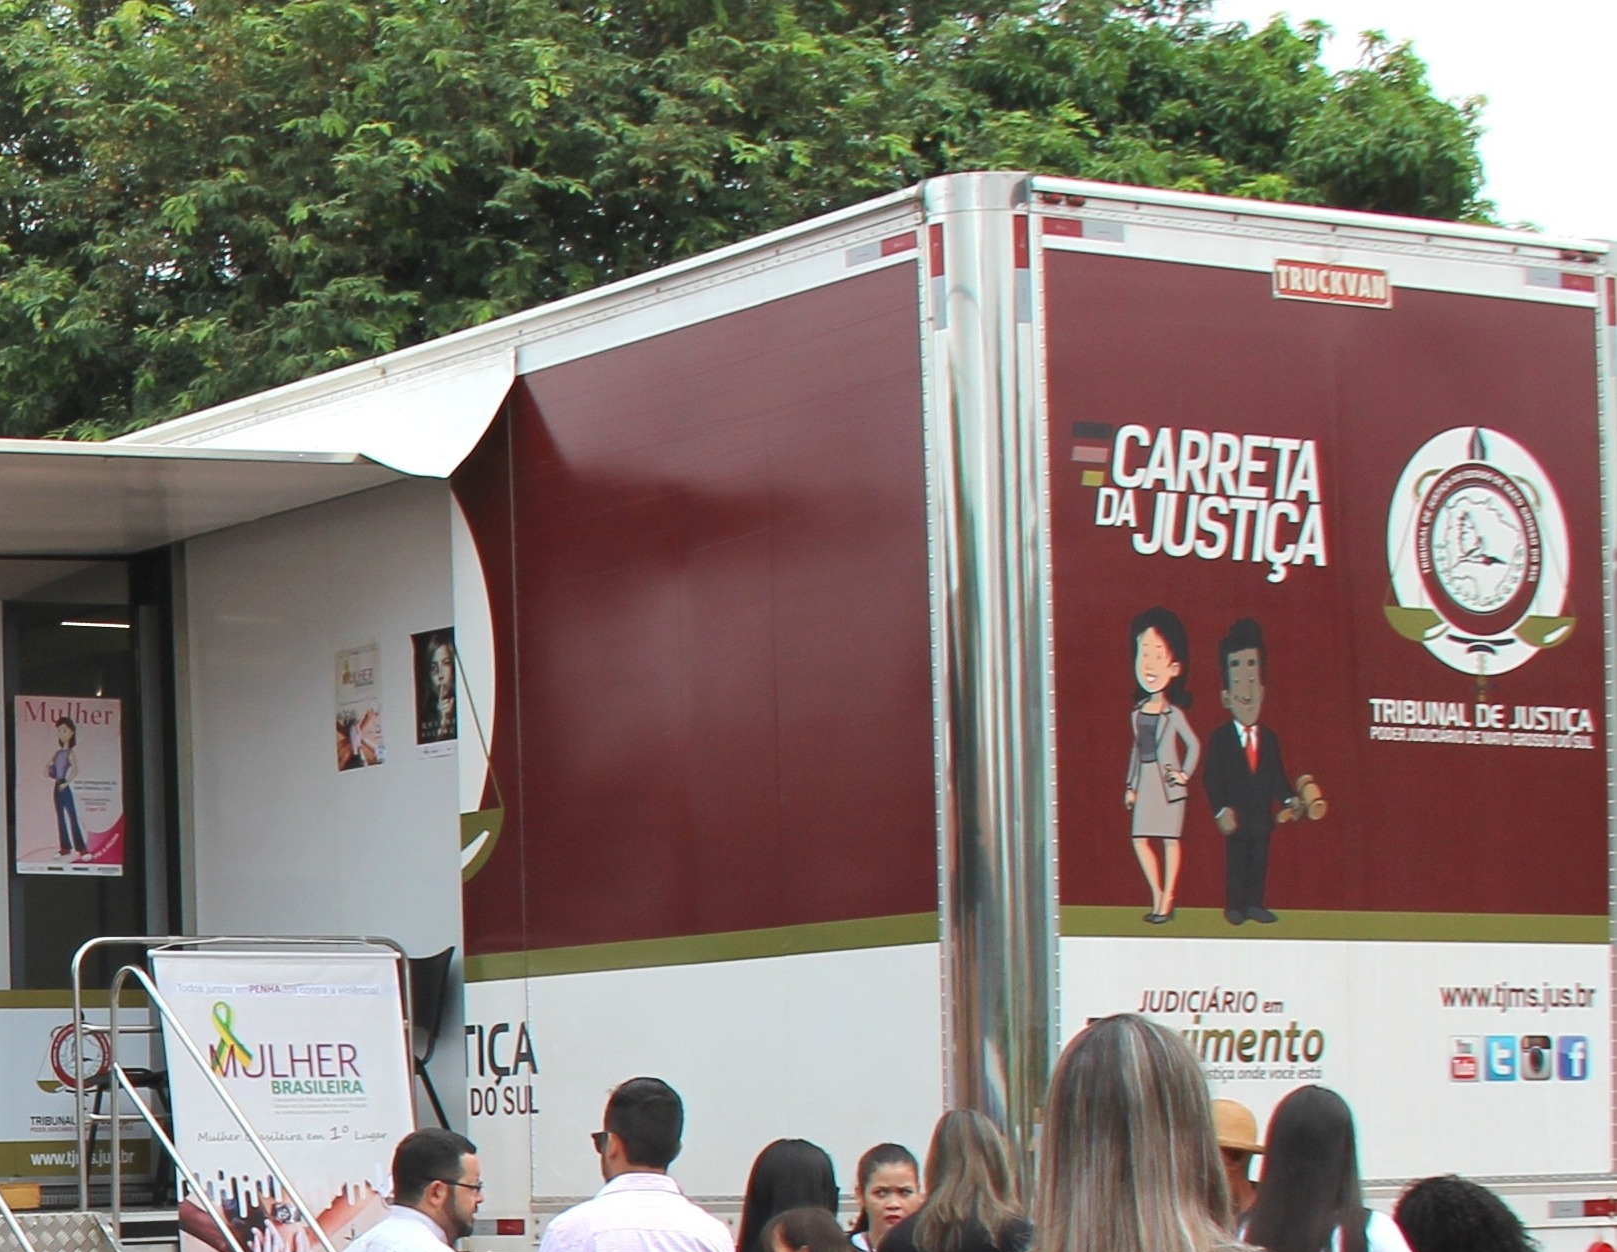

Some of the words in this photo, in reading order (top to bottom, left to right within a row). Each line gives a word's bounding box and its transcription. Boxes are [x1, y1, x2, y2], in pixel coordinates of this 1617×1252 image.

[1277, 265, 1386, 299] TRUCKVAN
[1112, 424, 1321, 503] CARRETA
[1095, 487, 1137, 527] DA
[1133, 491, 1327, 582] JUSTIÇA
[24, 701, 113, 725] Mulher
[1369, 698, 1471, 728] TRIBUNAL
[1475, 703, 1504, 729] DE
[1509, 706, 1595, 735] JUSTIÇA
[1370, 726, 1406, 741] PODER
[1407, 727, 1464, 744] JUDICIÁRIO
[1466, 730, 1481, 745] DE
[1482, 732, 1510, 746] MATO
[1512, 733, 1554, 748] GROSSO
[1556, 734, 1573, 749] DO
[1574, 736, 1595, 750] SUL
[177, 983, 204, 994] Todos
[205, 984, 233, 995] juntos
[300, 985, 328, 995] contra
[1138, 986, 1258, 1014] JUDICIÁRIO
[1262, 1001, 1283, 1014] em
[1439, 982, 1596, 1013] www.tjms.jus.br
[1182, 1015, 1325, 1064] imento
[209, 1043, 361, 1079] MULHER
[1238, 1066, 1266, 1080] onde
[1269, 1064, 1295, 1080] você
[271, 1080, 364, 1096] BRASILEIRA
[470, 1086, 497, 1117] DO
[503, 1086, 539, 1115] SUL
[30, 1116, 76, 1126] TRIBUNAL
[197, 1130, 240, 1142] Mulher
[306, 1133, 325, 1142] em
[354, 1131, 388, 1144] Lugar
